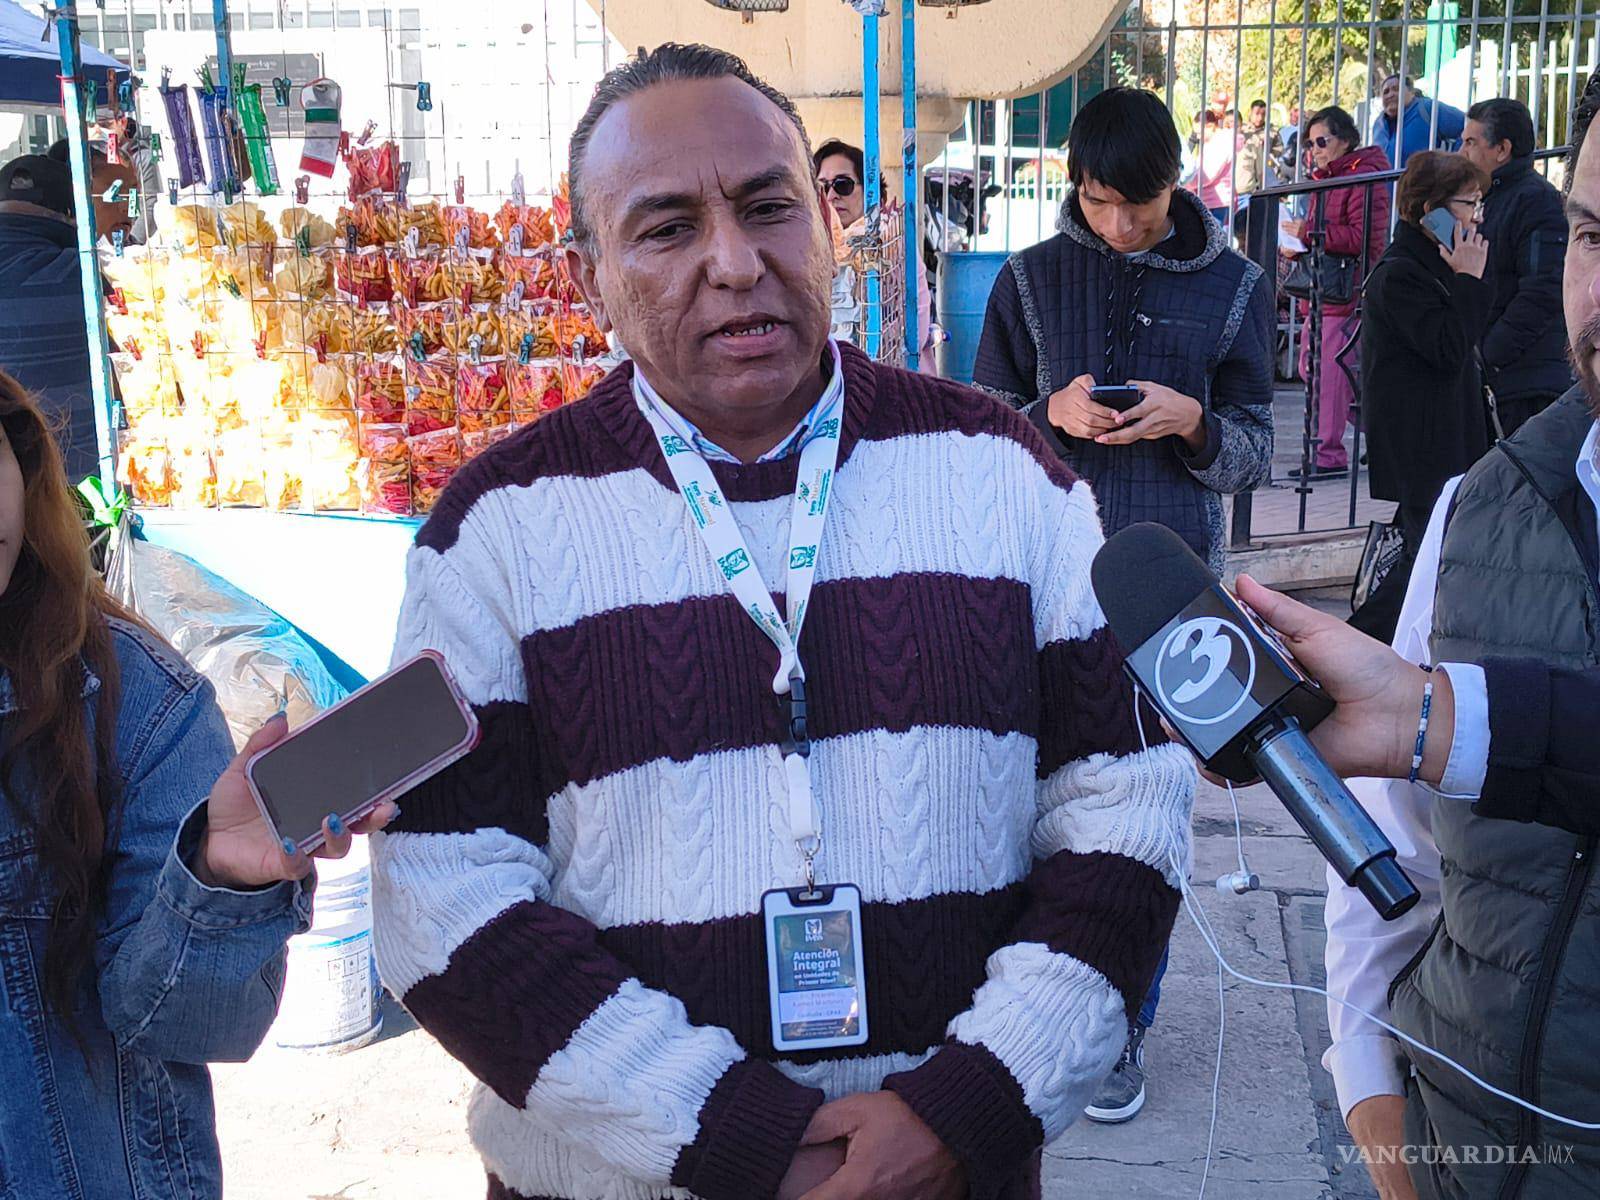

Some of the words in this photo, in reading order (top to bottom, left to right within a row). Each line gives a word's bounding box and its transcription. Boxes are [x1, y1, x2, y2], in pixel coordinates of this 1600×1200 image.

[828, 418, 839, 439] IMSS
[661, 435, 677, 457] IMSS
[806, 545, 817, 567] IMSS
[717, 557, 733, 581] IMSS
[1169, 620, 1232, 703] 3
[793, 949, 839, 960] Atención
[793, 958, 841, 971] Integral
